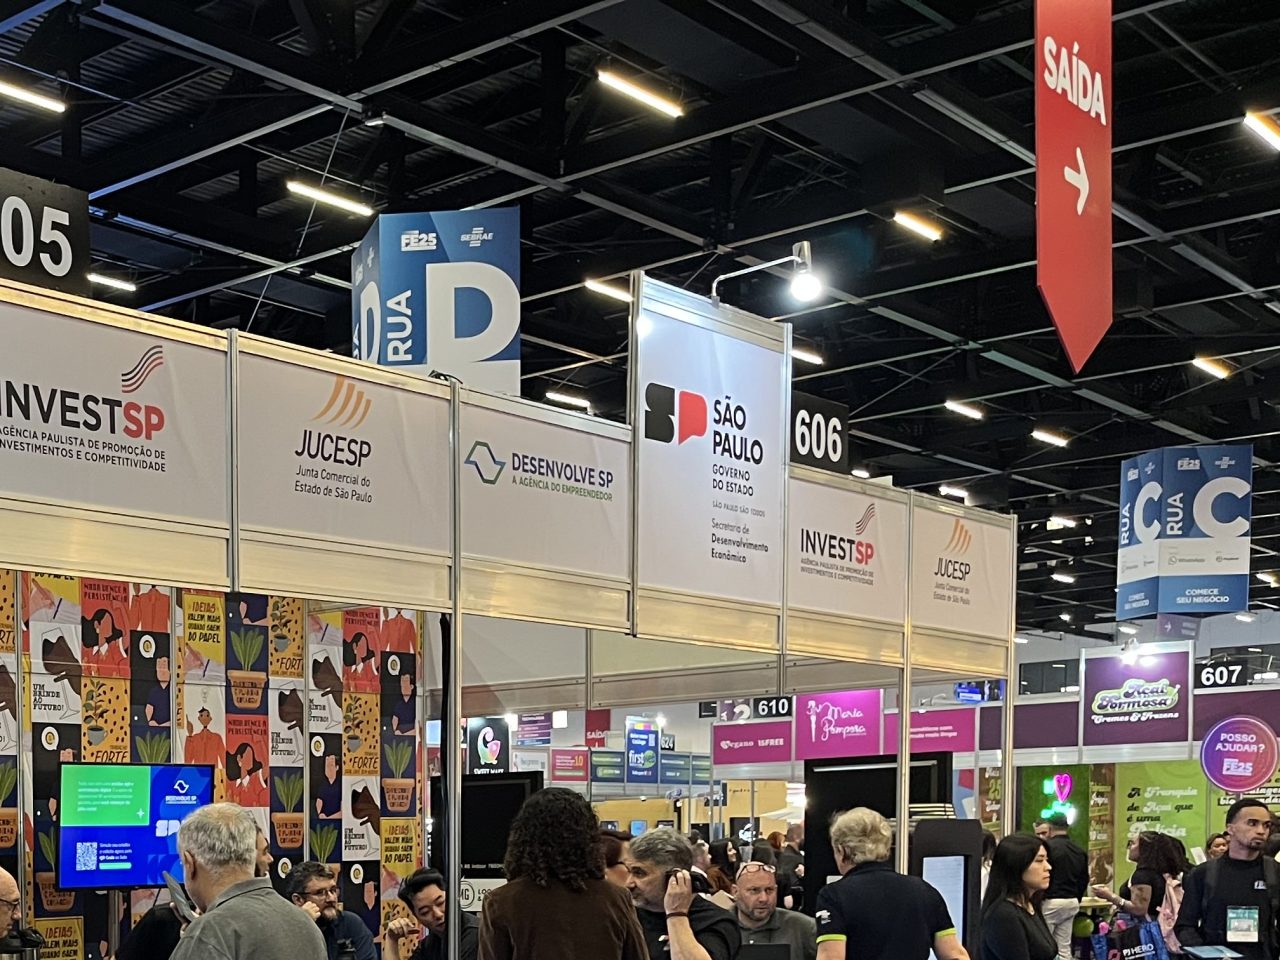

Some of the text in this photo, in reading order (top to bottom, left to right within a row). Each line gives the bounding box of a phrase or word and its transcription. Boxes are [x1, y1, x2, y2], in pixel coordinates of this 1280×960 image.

[1043, 35, 1107, 126] SAÍDA
[386, 261, 521, 363] RUA D
[713, 395, 746, 431] SÃO
[41, 431, 86, 448] PAULISTA
[88, 439, 100, 450] DE
[102, 442, 153, 458] PROMOÇÃO
[154, 450, 166, 460] DE
[794, 408, 842, 463] 606
[294, 429, 372, 468] JUCESP
[712, 430, 764, 465] PAULO
[76, 450, 82, 460] E
[84, 451, 166, 473] COMPETITIVIDADE
[511, 452, 614, 488] DESENVOLVE SP
[712, 464, 750, 481] GOVERNO
[296, 464, 371, 487] Junta Comercial do
[712, 478, 754, 496] DO ESTADO
[294, 480, 372, 503] Estado de São Paulo
[512, 475, 613, 501] A AGÊNCIA DO EMPREENDEDOR
[1166, 476, 1252, 539] RUA C
[1120, 502, 1131, 544] RUA
[711, 533, 769, 552] Desenvolvimento
[800, 528, 875, 565] INVESTSP
[711, 547, 746, 562] Econômico
[933, 557, 971, 582] JUCESP
[1176, 594, 1230, 604] SEU NEGÓCIO
[1185, 588, 1218, 596] COMECE
[199, 632, 220, 644] PAPEL
[1201, 665, 1242, 686] 607
[758, 699, 789, 716] 610
[661, 735, 674, 749] 624
[1215, 743, 1265, 753] AJUDAR?
[1220, 733, 1257, 743] POSSO
